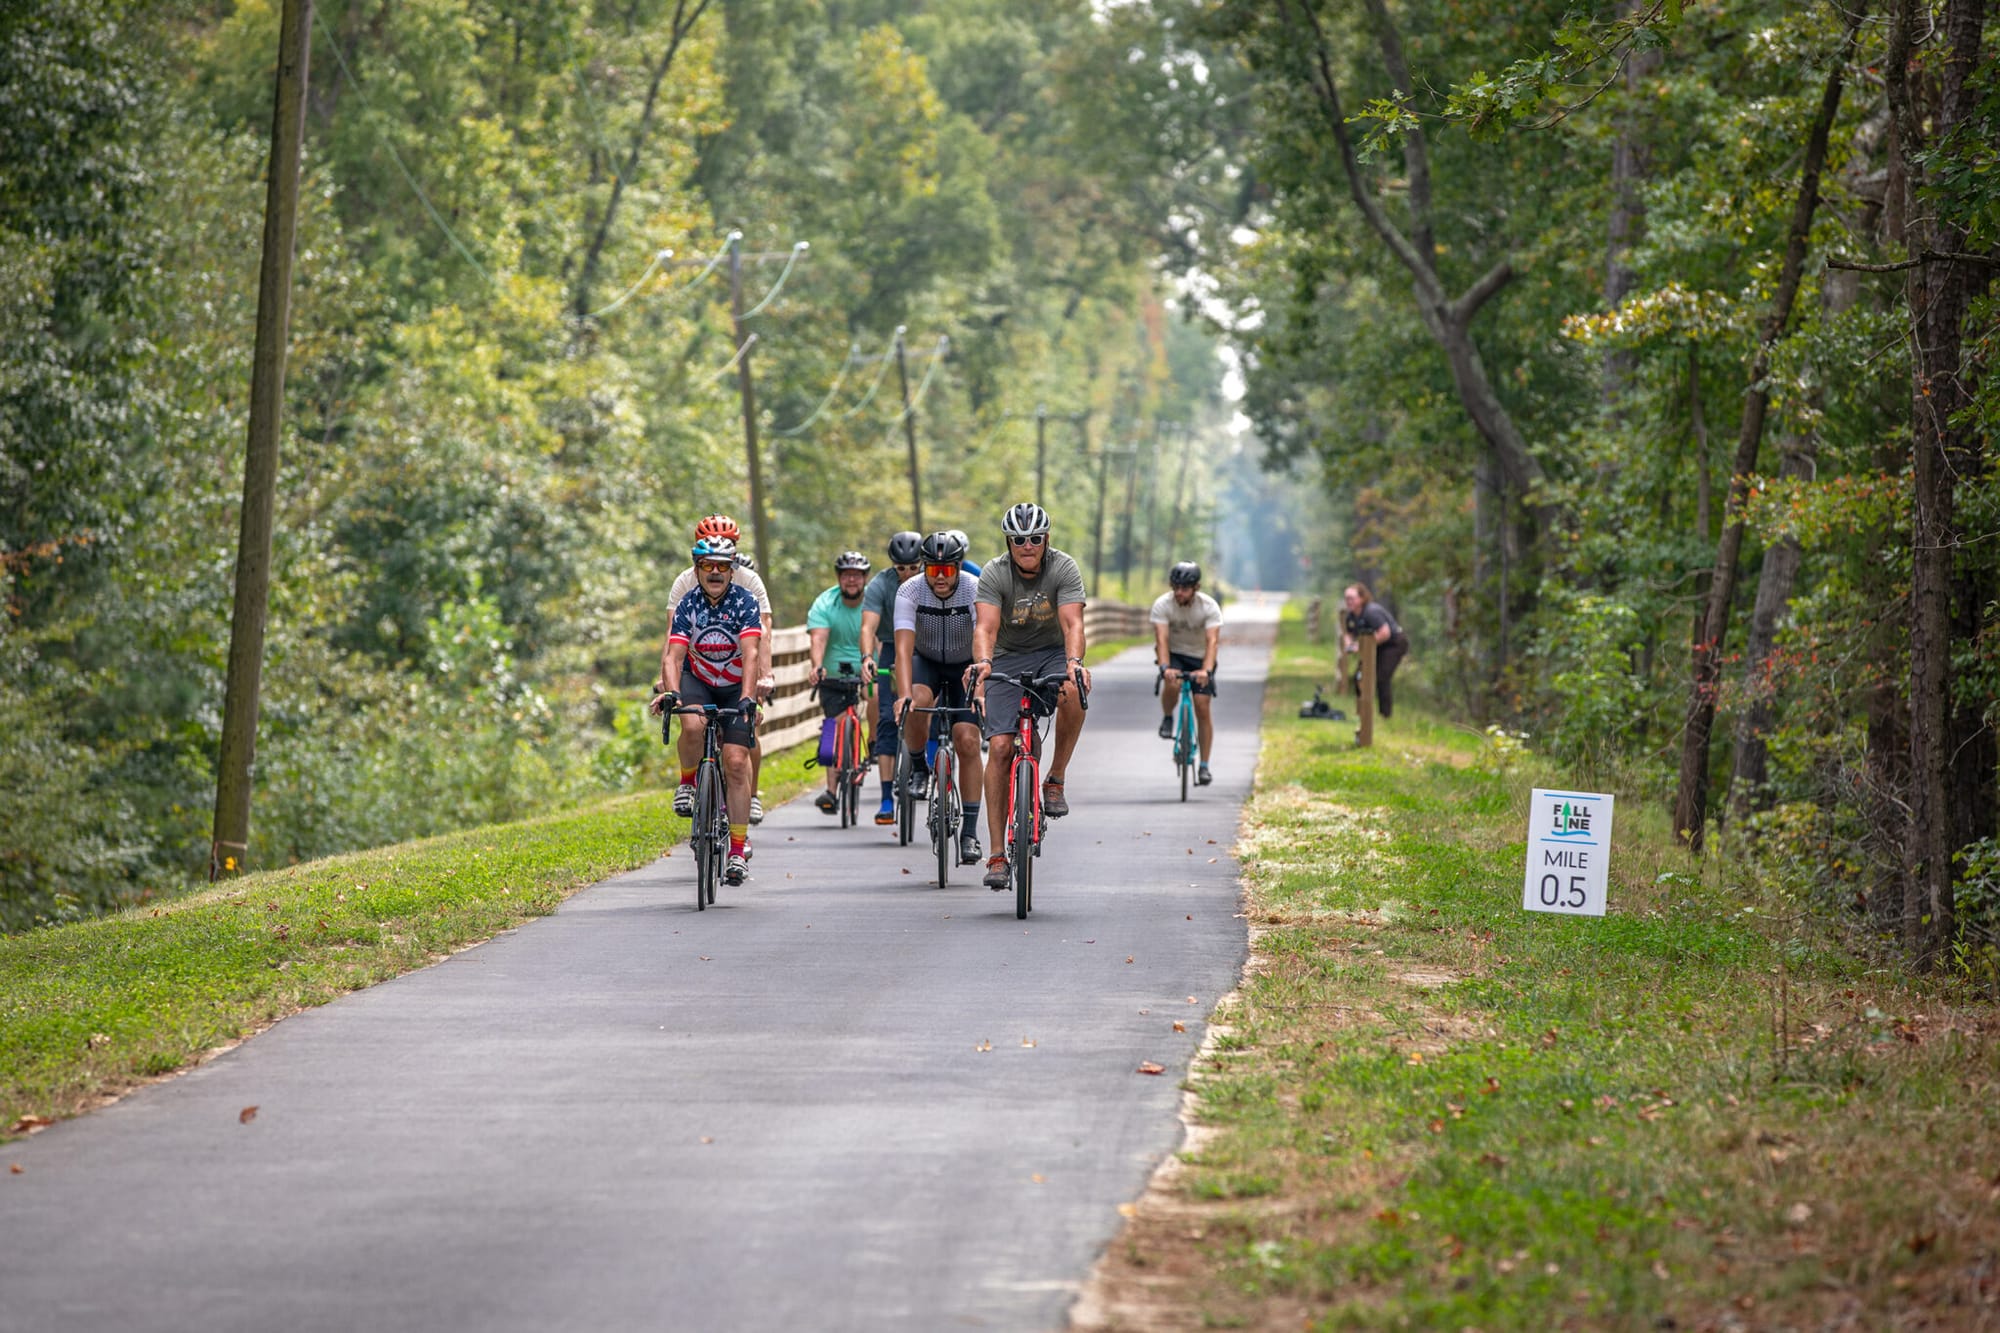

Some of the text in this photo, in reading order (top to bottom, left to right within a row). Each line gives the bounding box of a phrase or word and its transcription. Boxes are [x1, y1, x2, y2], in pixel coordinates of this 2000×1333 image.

[1553, 801, 1591, 817] FALL
[1554, 817, 1590, 830] LINE
[1544, 849, 1588, 869] MILE
[1540, 874, 1586, 908] 0.5
